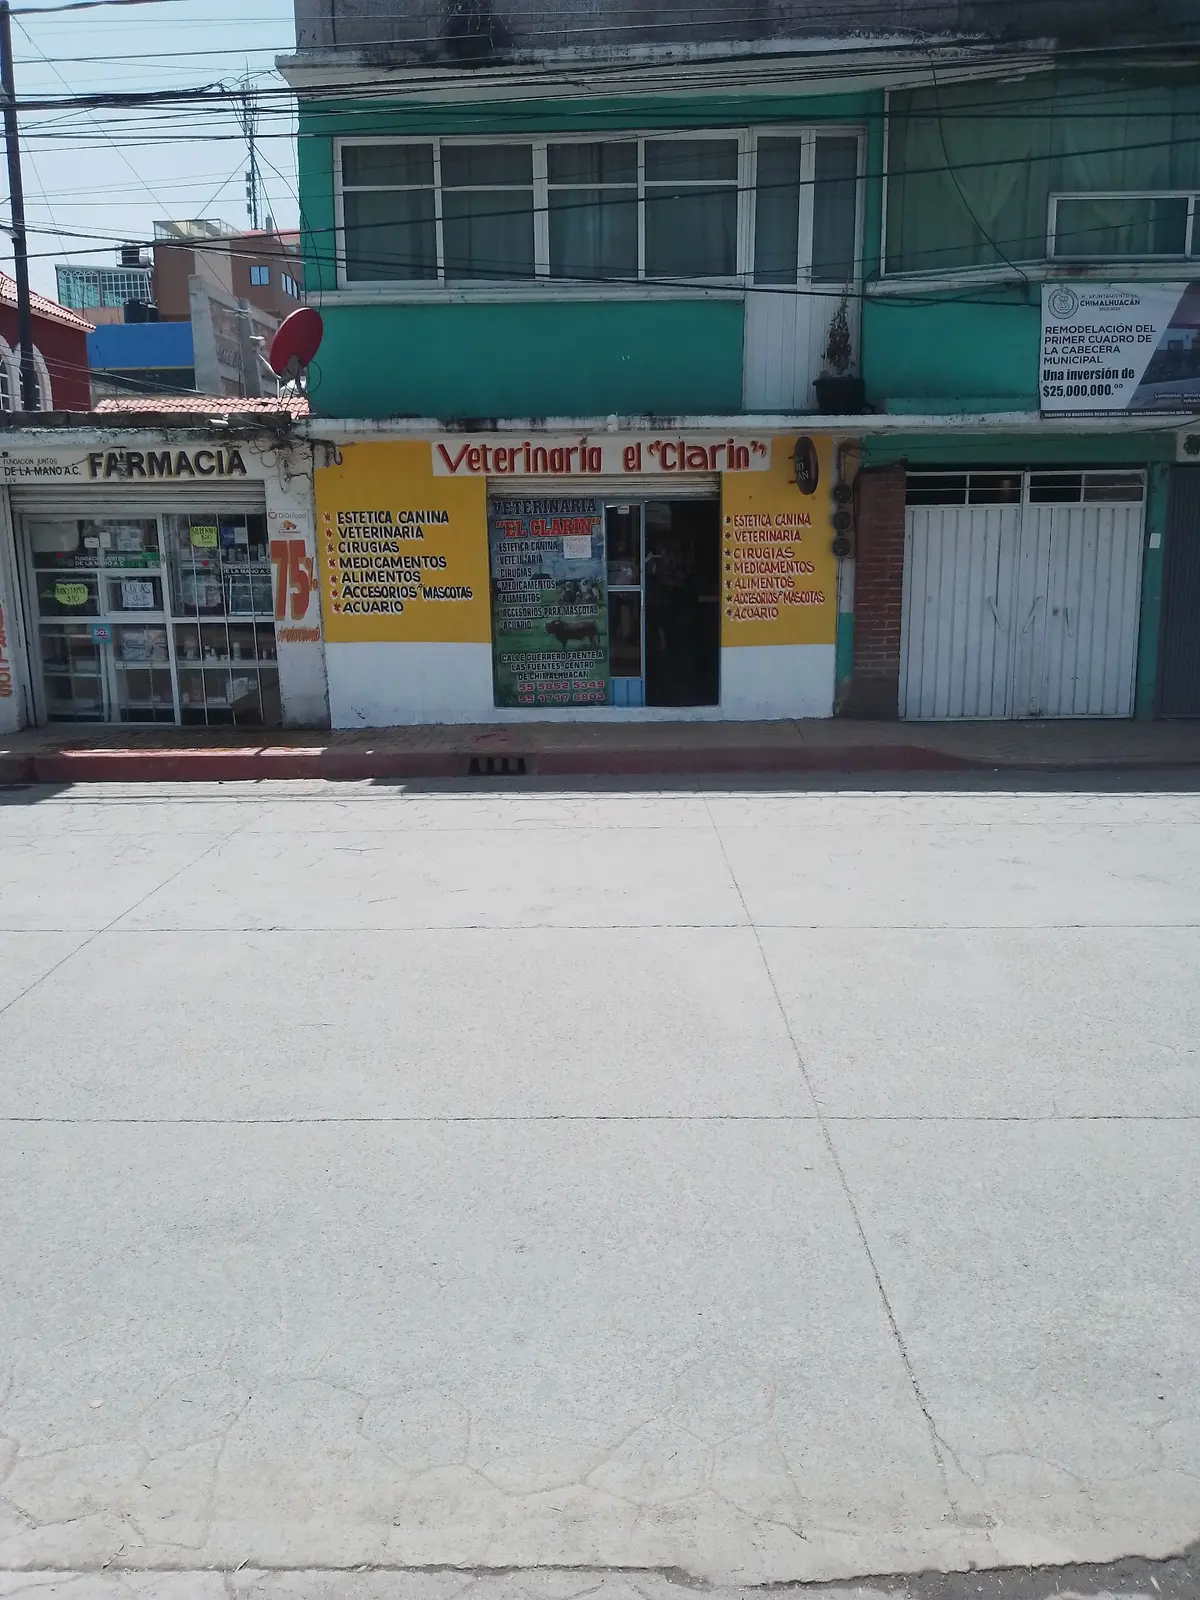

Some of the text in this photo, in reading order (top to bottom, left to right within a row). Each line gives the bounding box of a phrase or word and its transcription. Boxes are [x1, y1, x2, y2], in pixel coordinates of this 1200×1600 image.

[1080, 298, 1140, 306] CHIMALHUACÁN
[1045, 322, 1156, 334] REMODELACIÓN DEL
[1044, 334, 1152, 344] PRIMER CUADRO DE
[1044, 345, 1121, 354] LA CABECERA
[1044, 356, 1103, 365] MUNICIPAL
[1043, 367, 1134, 381] Una inversión de
[38, 458, 58, 466] JUNTOS
[436, 441, 602, 474] Veterinaria
[622, 442, 642, 472] el
[88, 450, 247, 478] FARMACIA
[4, 466, 82, 476] DE LA MANO A.C.
[494, 498, 597, 516] VETERINARIA
[337, 510, 449, 524] ESTETICA CANINA
[734, 512, 812, 527] ESTETICA CANINA
[338, 526, 424, 539] VETERINARIA
[734, 530, 802, 542] VETERINARIA
[338, 541, 400, 553] CIRUGIAS
[499, 541, 528, 552] ESTETICA
[531, 541, 558, 552] CANINA
[733, 547, 795, 559] CIRUGIAS
[339, 556, 447, 569] MEDICAMENTOS
[500, 554, 543, 565] VETERINARIA
[500, 568, 532, 578] CIRUGIAS
[733, 561, 815, 574] MEDICAMENTOS
[342, 571, 420, 584] ALIMENTOS
[734, 576, 795, 589] ALIMENTOS
[501, 580, 556, 591] MEDICAMENTOS
[342, 586, 417, 599] ACCESORIOS
[423, 586, 472, 599] MASCOTAS
[502, 593, 540, 603] ALIMENTOS
[733, 592, 778, 604] ACCESORIOS
[783, 591, 825, 604] MASCOTAS
[342, 601, 404, 613] ACUARIO
[503, 605, 598, 617] ACCESORIOS PARA MASCOTAS
[734, 607, 779, 619] ACUARIO
[503, 620, 532, 630] ACUARIO
[501, 651, 603, 662] CALLE GUERRERO FRENTE A
[512, 663, 526, 672] LAS
[564, 661, 595, 669] CENTRO
[529, 671, 589, 680] CHIMALHUACAN
[518, 683, 534, 691] 55
[573, 680, 605, 689] 5349
[538, 694, 570, 702] 1717
